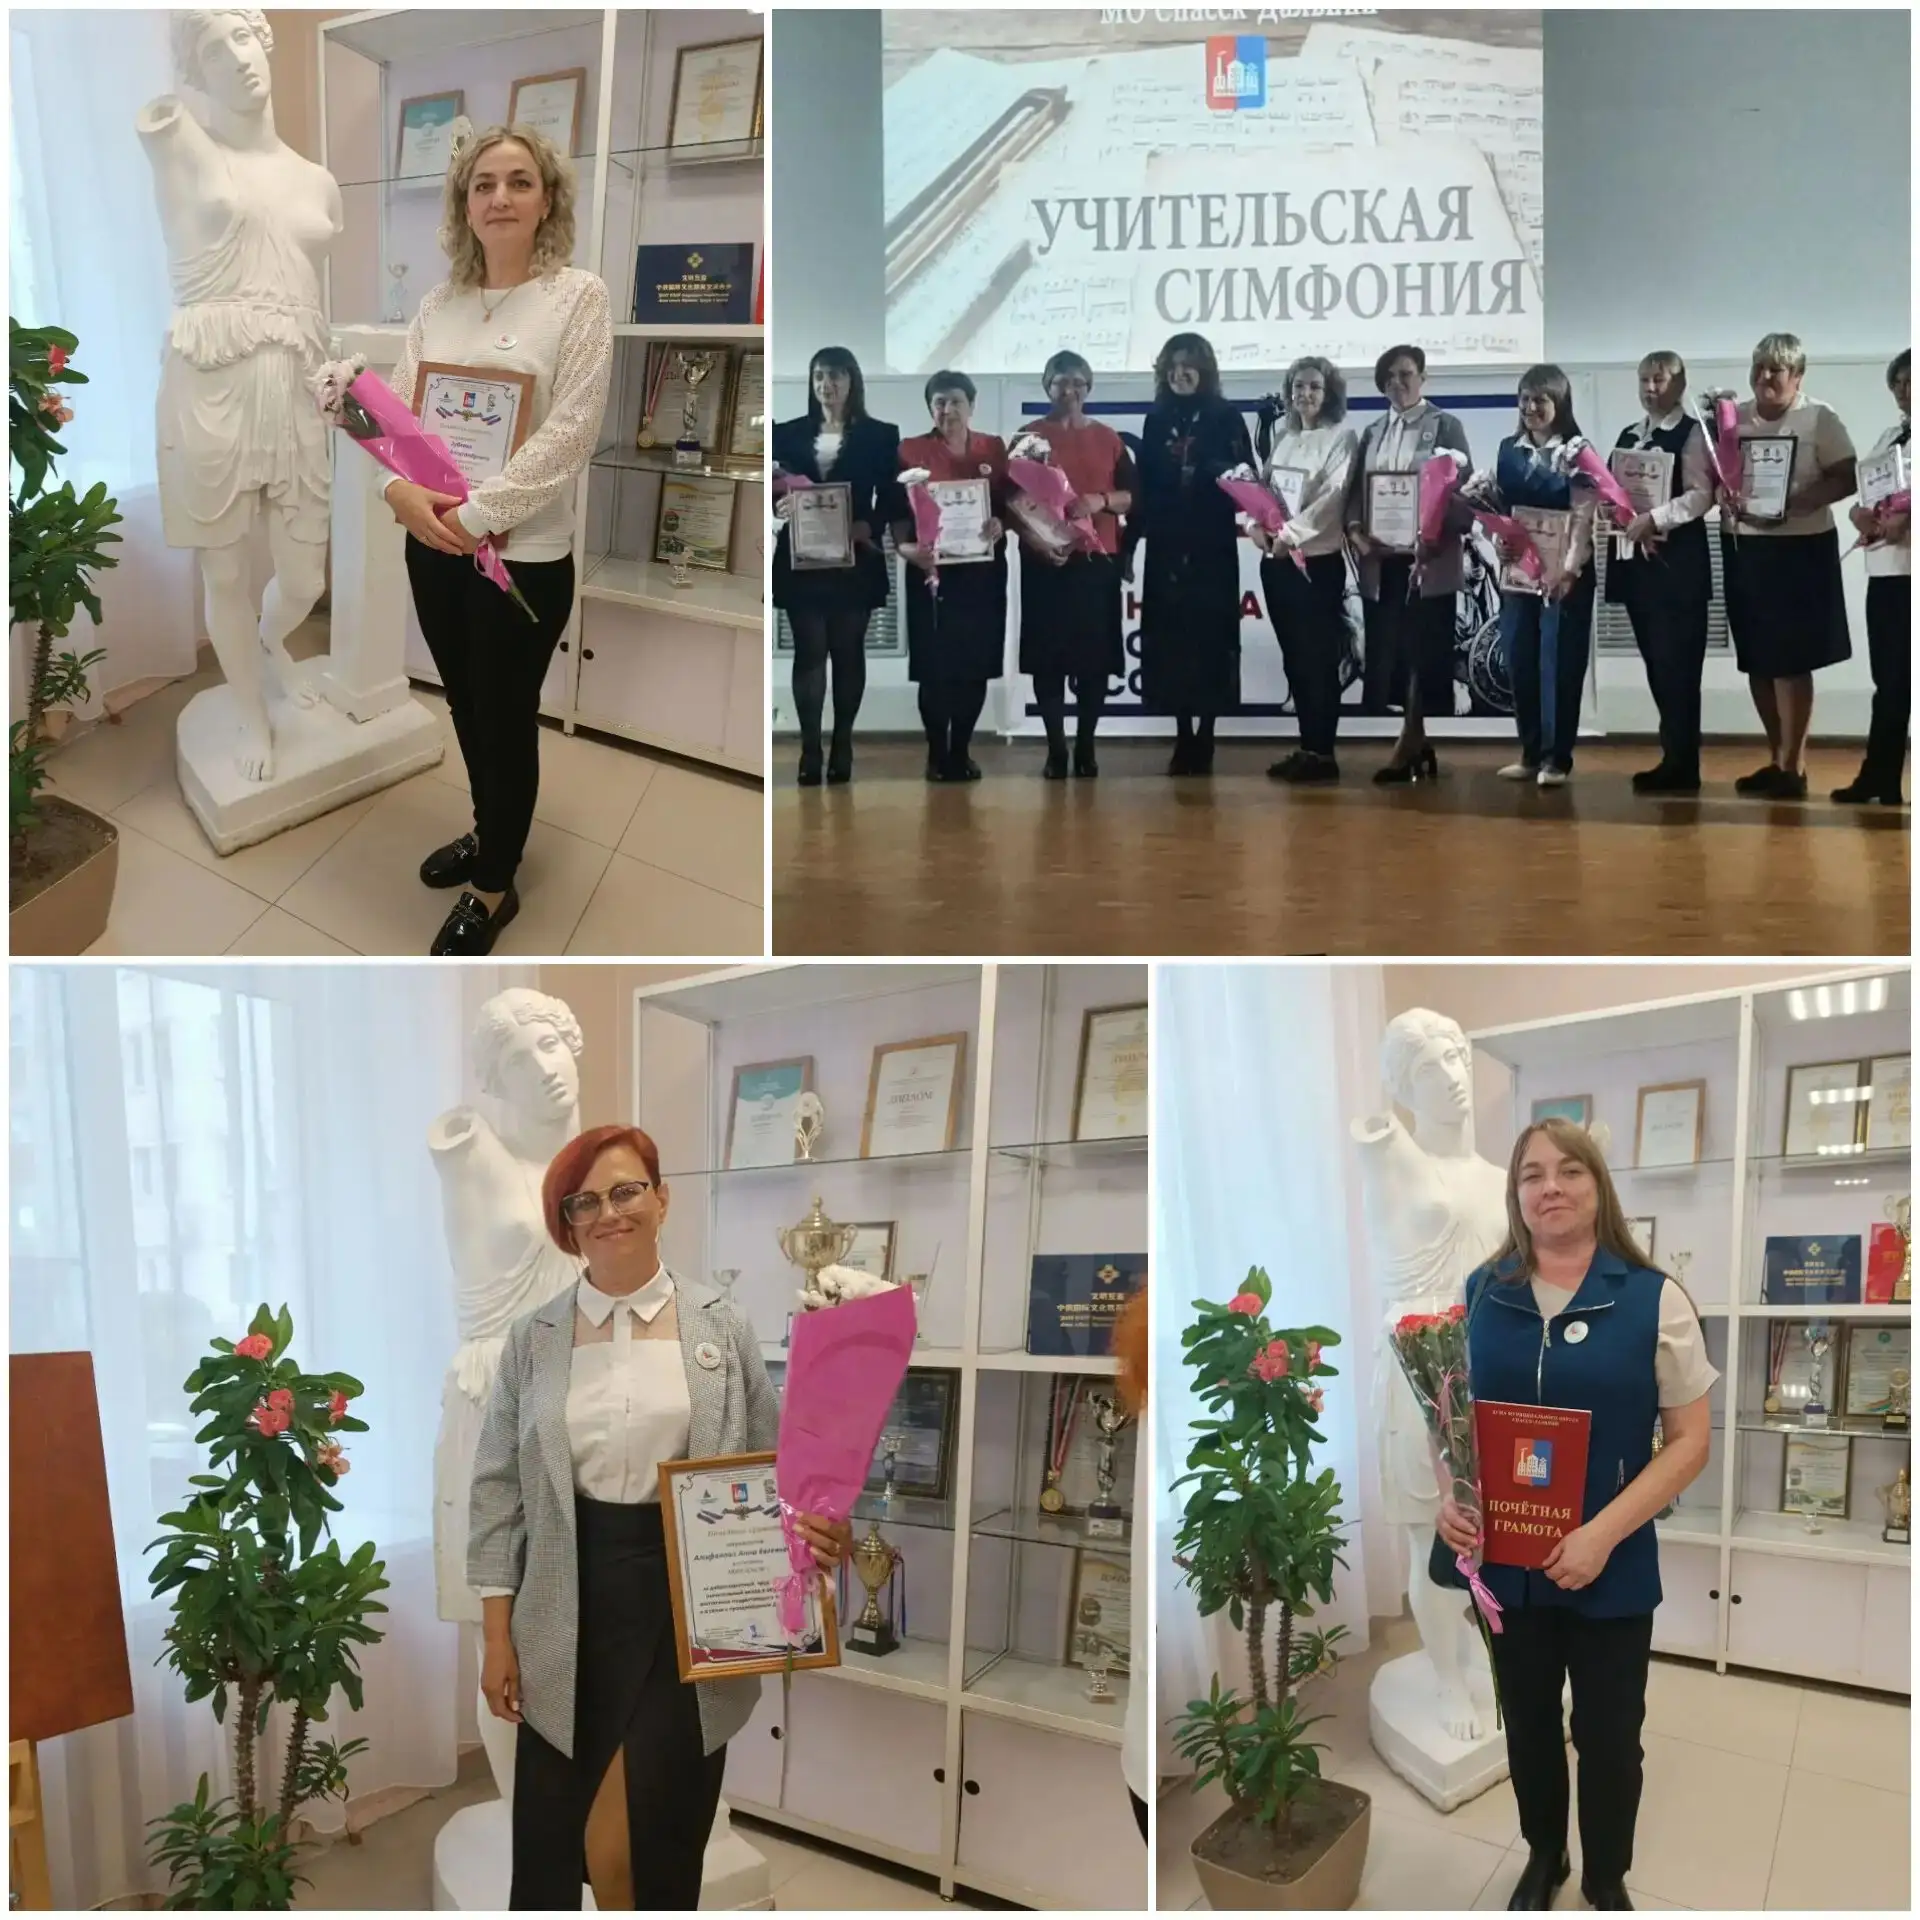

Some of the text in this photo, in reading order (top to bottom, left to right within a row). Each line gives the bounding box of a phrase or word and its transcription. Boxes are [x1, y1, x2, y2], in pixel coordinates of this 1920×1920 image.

[1031, 185, 1474, 256] УЧИТЕЛЬСКАЯ
[1154, 258, 1527, 325] СИМФОНИЯ
[1489, 1500, 1571, 1519] ПОЧЁТНАЯ
[1494, 1520, 1562, 1537] ГРАМОТА
